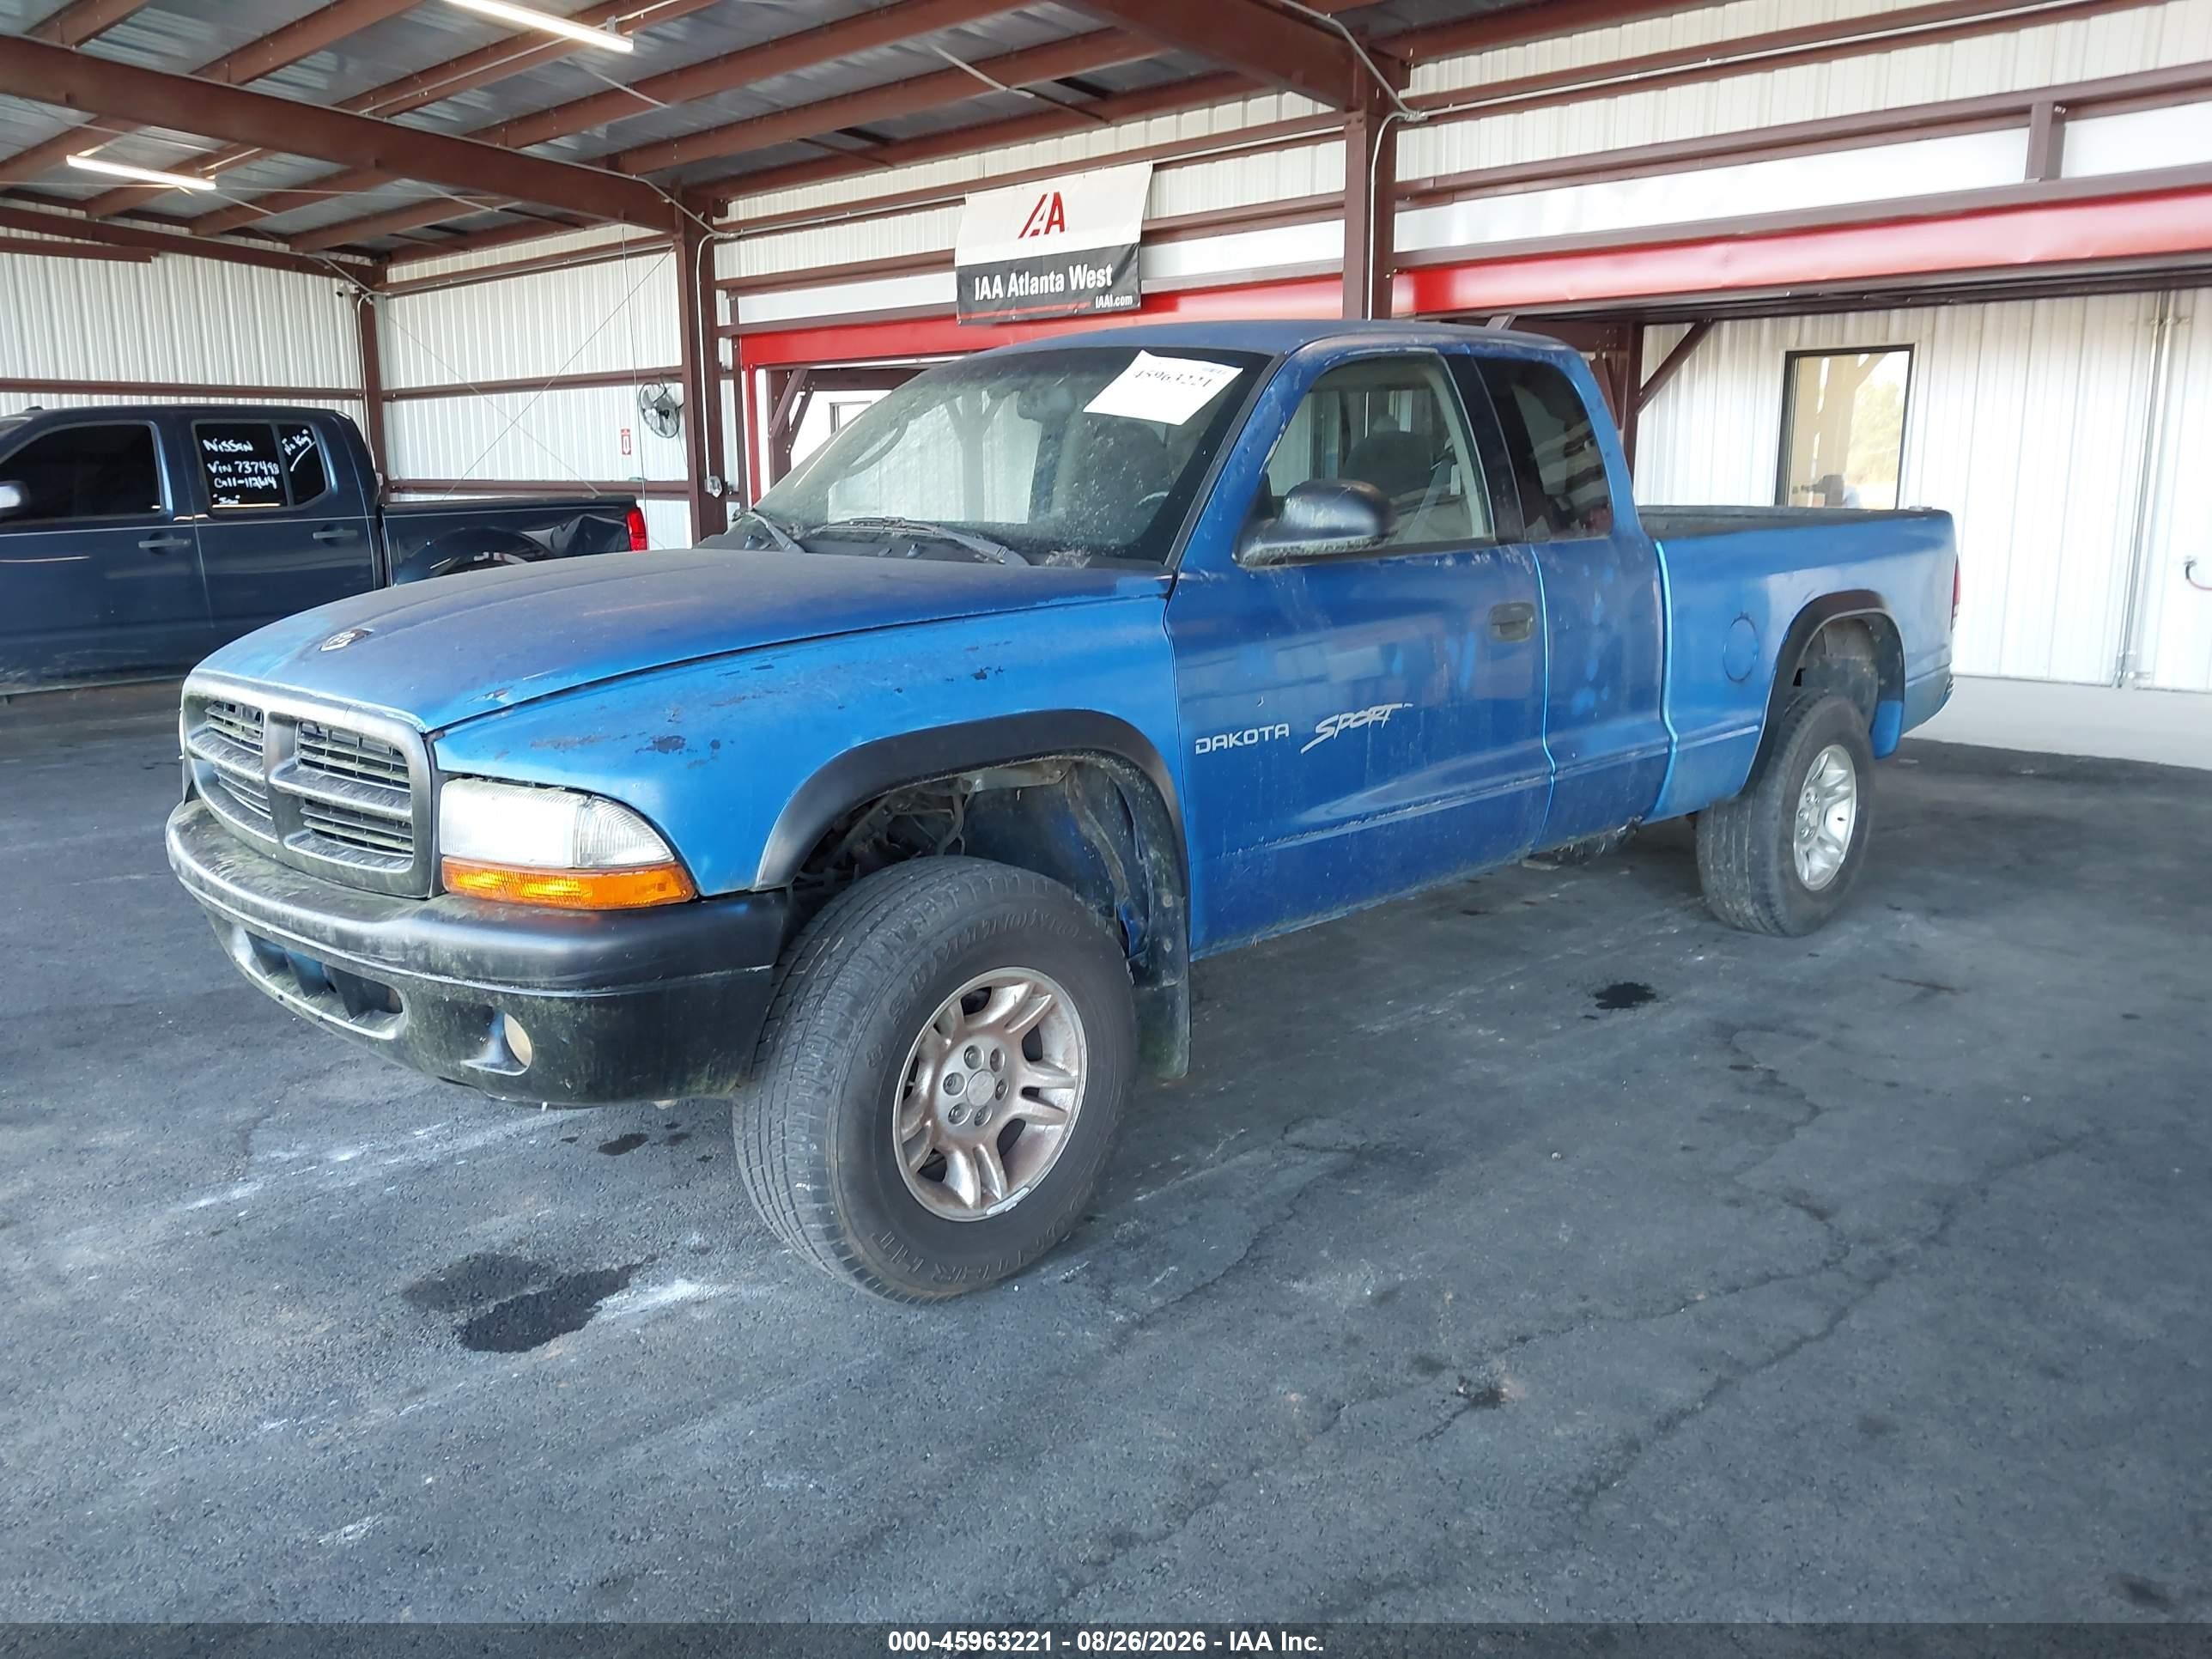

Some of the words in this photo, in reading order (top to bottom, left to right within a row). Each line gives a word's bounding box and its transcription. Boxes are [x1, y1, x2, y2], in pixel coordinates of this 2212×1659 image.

[975, 275, 1004, 301] IAA
[1006, 269, 1065, 298] Atlanta
[1068, 263, 1113, 290] West
[1095, 294, 1133, 309] IAAI.com
[1194, 723, 1290, 755] DAKOTA
